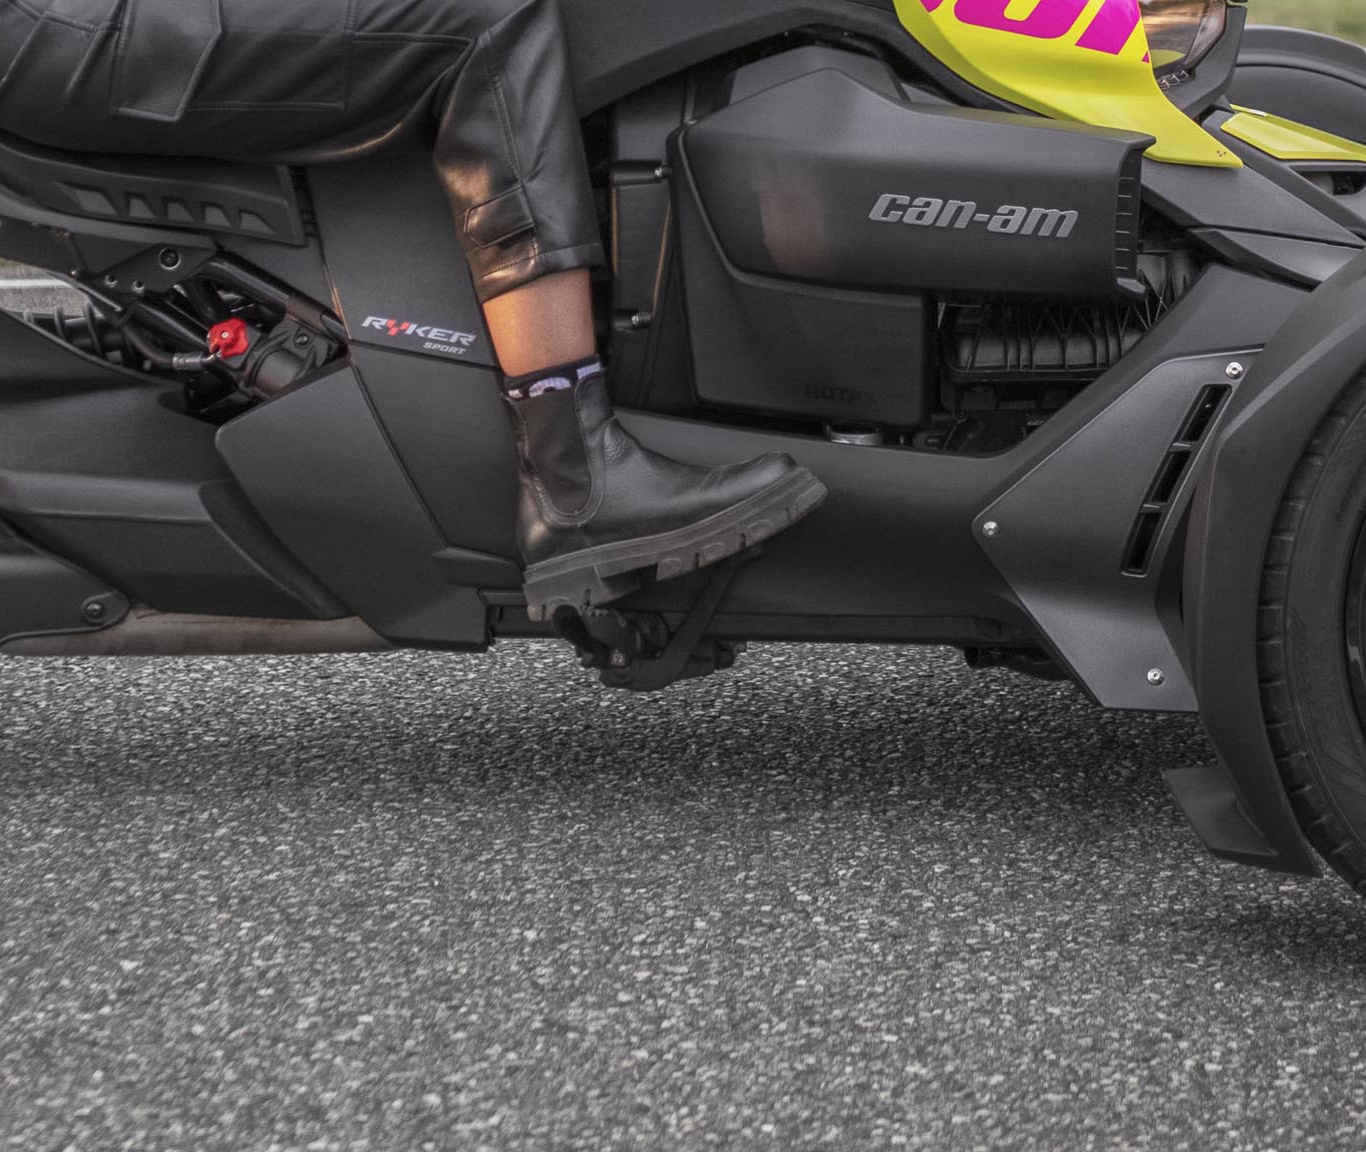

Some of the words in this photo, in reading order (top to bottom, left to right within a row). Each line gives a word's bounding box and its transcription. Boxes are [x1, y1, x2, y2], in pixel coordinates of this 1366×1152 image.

[868, 193, 1078, 238] can-am
[361, 316, 476, 346] RYKER
[424, 341, 467, 355] SPORT
